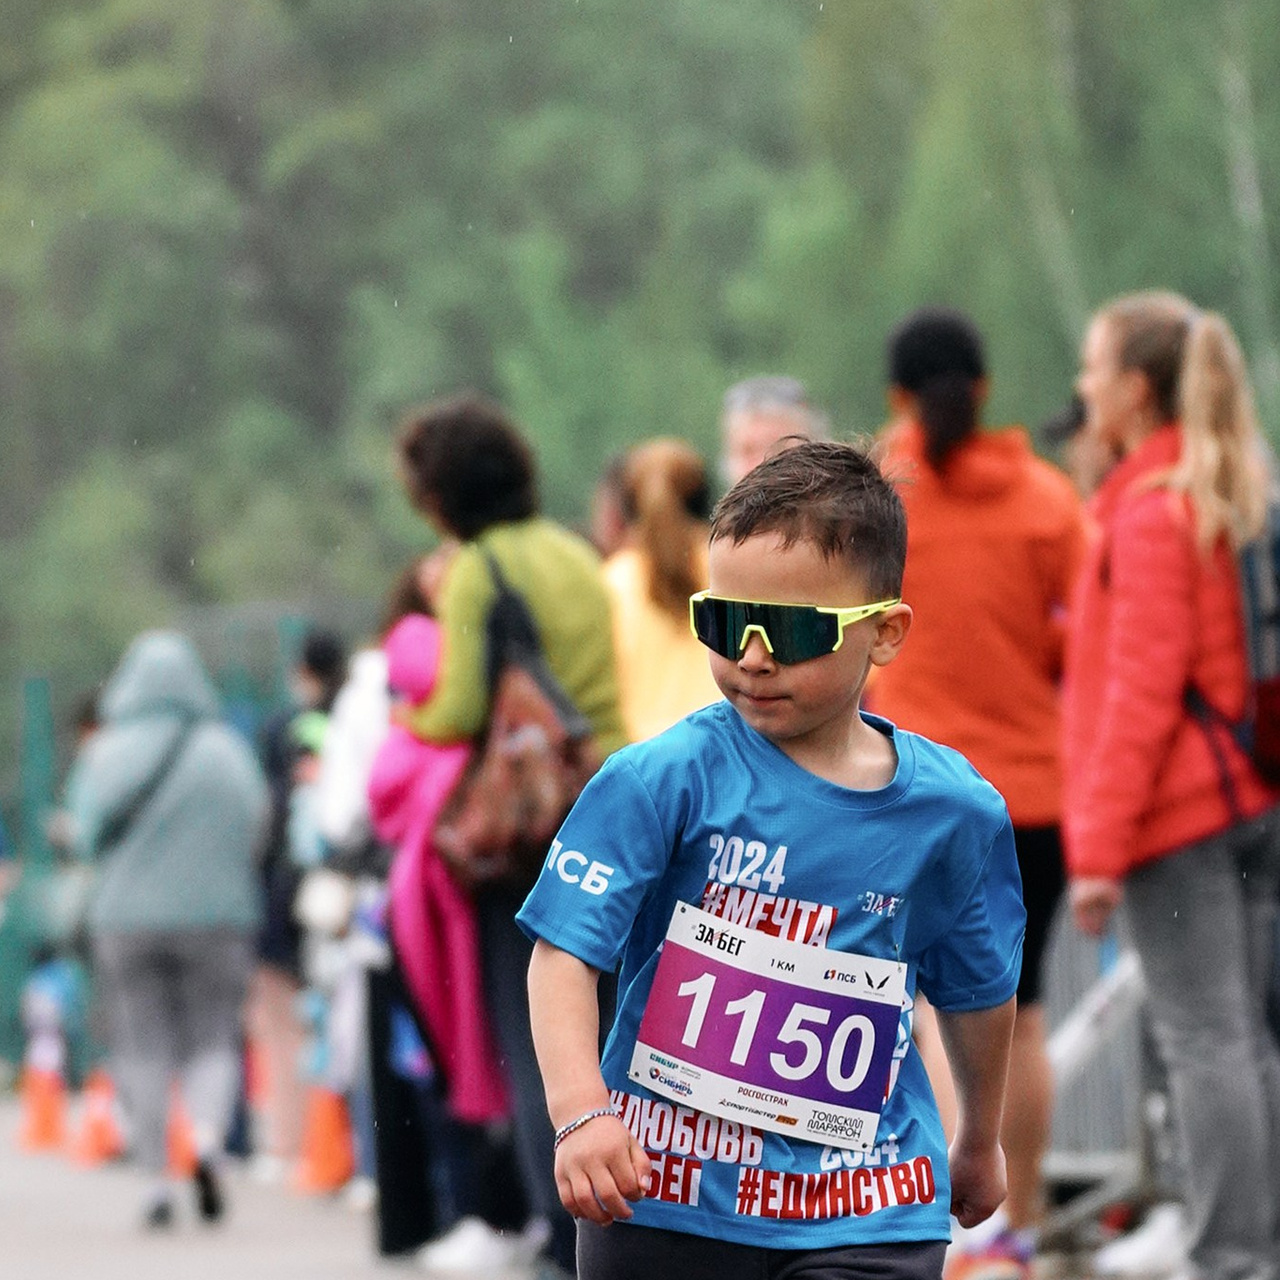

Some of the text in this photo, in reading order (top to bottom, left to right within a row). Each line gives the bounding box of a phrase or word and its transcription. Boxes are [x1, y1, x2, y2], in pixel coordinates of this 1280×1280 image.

[707, 833, 788, 894] 2024
[702, 882, 837, 948] #МЕЧТА
[837, 972, 857, 984] ПСБ
[677, 972, 876, 1093] 1150
[609, 1089, 764, 1166] #ЛЮБОВЬ
[737, 1086, 789, 1107] РОСГОССТРАХ
[737, 1156, 936, 1219] #ЕДИНСТВО
